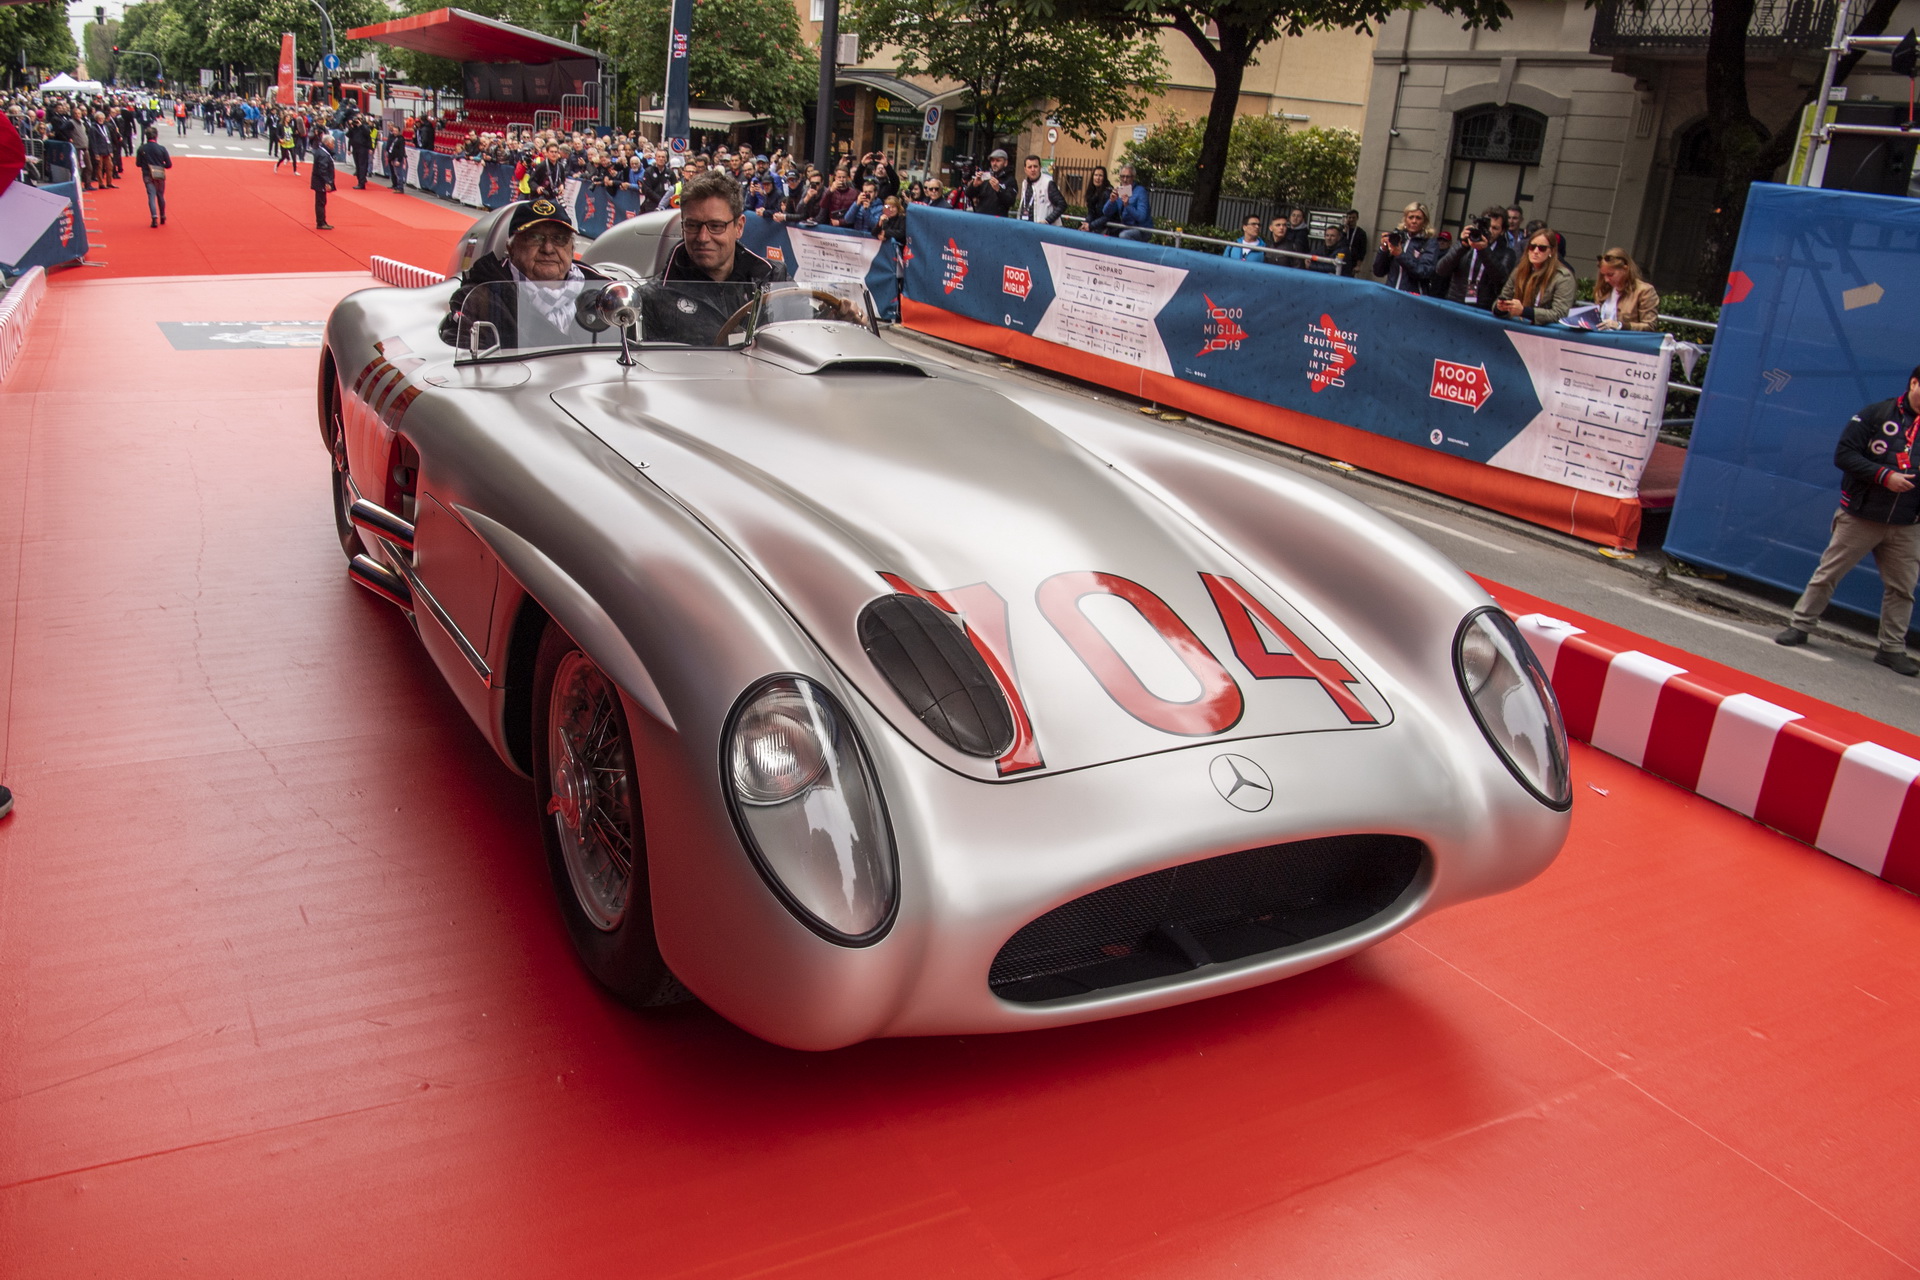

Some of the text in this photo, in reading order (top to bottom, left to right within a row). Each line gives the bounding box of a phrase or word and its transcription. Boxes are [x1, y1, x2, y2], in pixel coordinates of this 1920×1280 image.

[1006, 269, 1025, 281] 1000
[1095, 264, 1123, 275] CHOPARD
[942, 280, 964, 290] WORLD
[1004, 282, 1025, 295] MIGLIA
[1206, 308, 1243, 319] 1000
[1203, 324, 1242, 335] MIGLIA
[1308, 323, 1358, 342] THE MOST
[1203, 339, 1241, 351] 2019
[1303, 334, 1358, 355] BEAUTIFUL
[1313, 349, 1344, 364] RACE
[1309, 360, 1346, 376] IN THE
[1439, 365, 1477, 385] 1000
[1306, 371, 1346, 388] WORLD
[1433, 381, 1477, 403] MIGLIA
[874, 570, 1381, 778] 704
